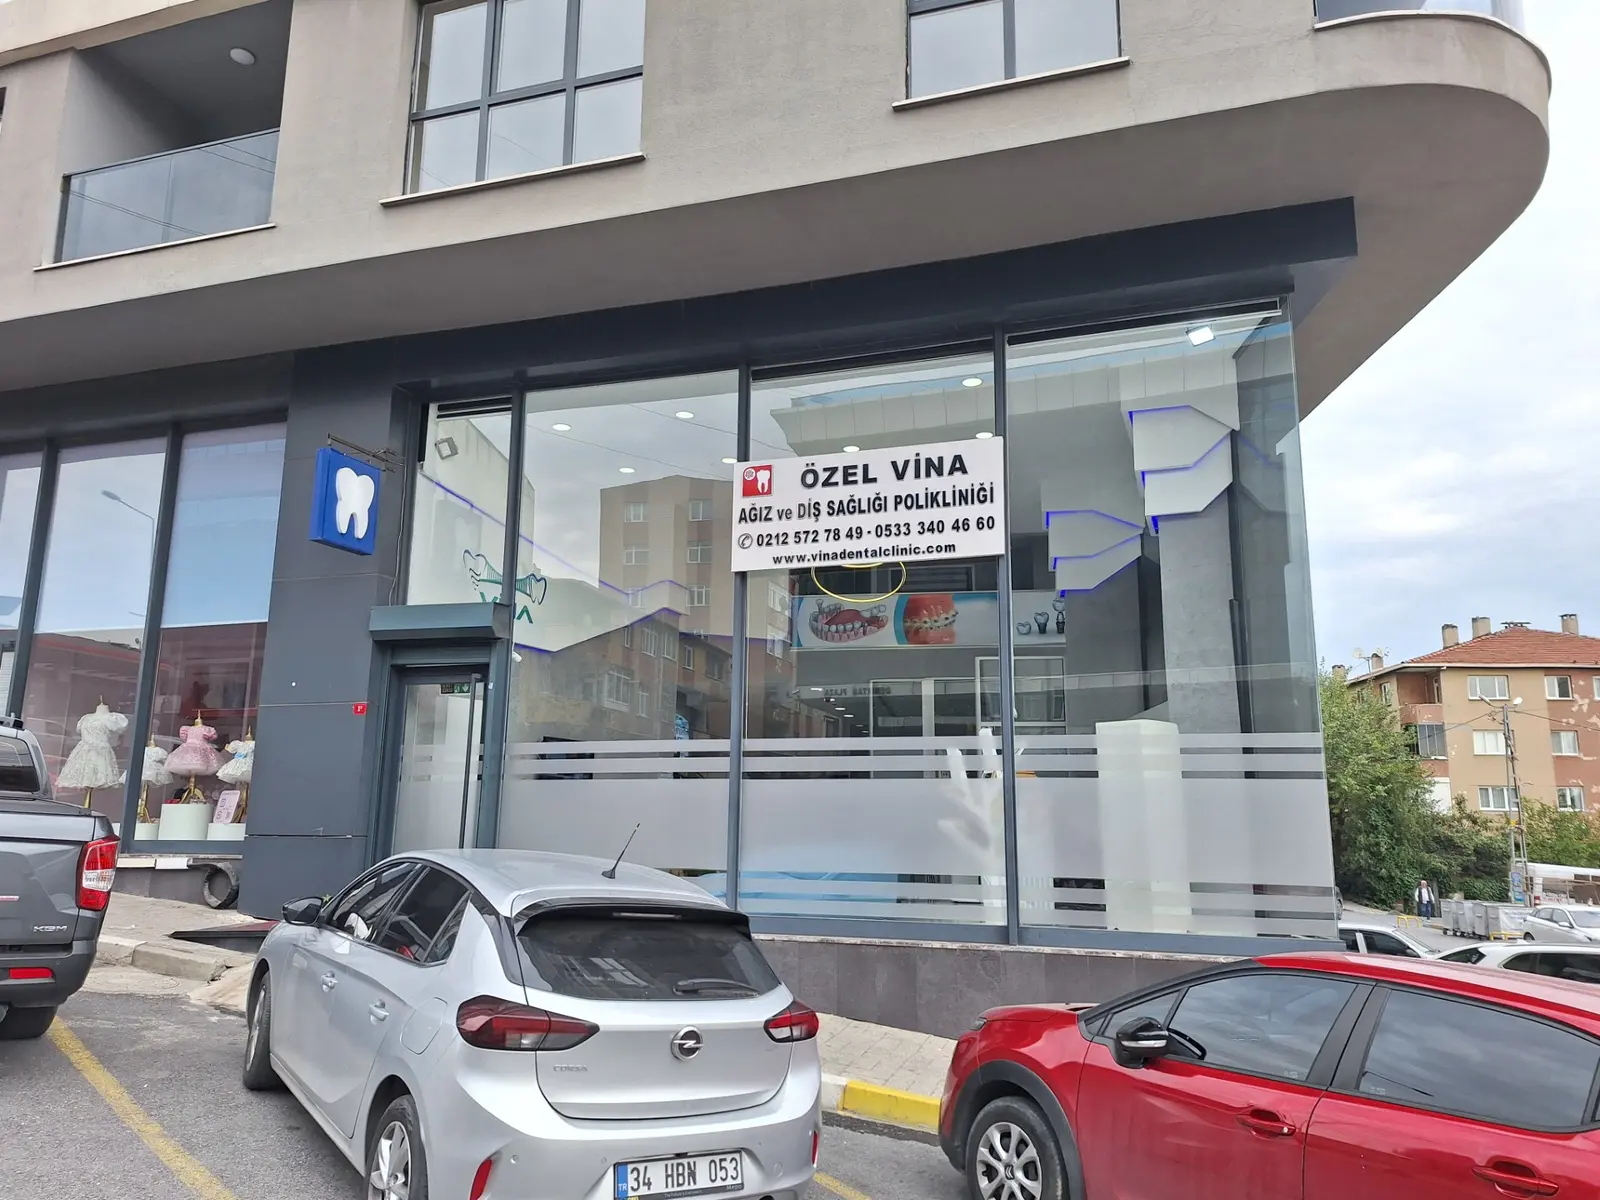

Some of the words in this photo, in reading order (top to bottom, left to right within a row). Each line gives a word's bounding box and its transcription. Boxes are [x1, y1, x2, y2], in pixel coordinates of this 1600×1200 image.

[800, 462, 878, 489] ÖZEL
[890, 452, 968, 481] VİNA
[738, 503, 773, 524] AĞIZ
[776, 507, 793, 520] ve
[797, 498, 821, 522] DİŞ
[826, 491, 888, 516] SAĞLIĞI
[894, 481, 994, 512] POLİKLİNİĞİ
[756, 532, 789, 547] 0212
[794, 529, 820, 544] 572
[824, 527, 841, 542] 78
[845, 525, 863, 541] 49
[875, 522, 911, 538] 0533
[917, 519, 945, 535] 340
[951, 517, 971, 533] 46
[976, 515, 995, 531] 60
[772, 543, 956, 565] www.vinadentalclinic.com
[618, 1183, 627, 1191] TR
[629, 1165, 652, 1192] 34
[664, 1160, 697, 1189] HBN
[708, 1157, 739, 1183] 053
